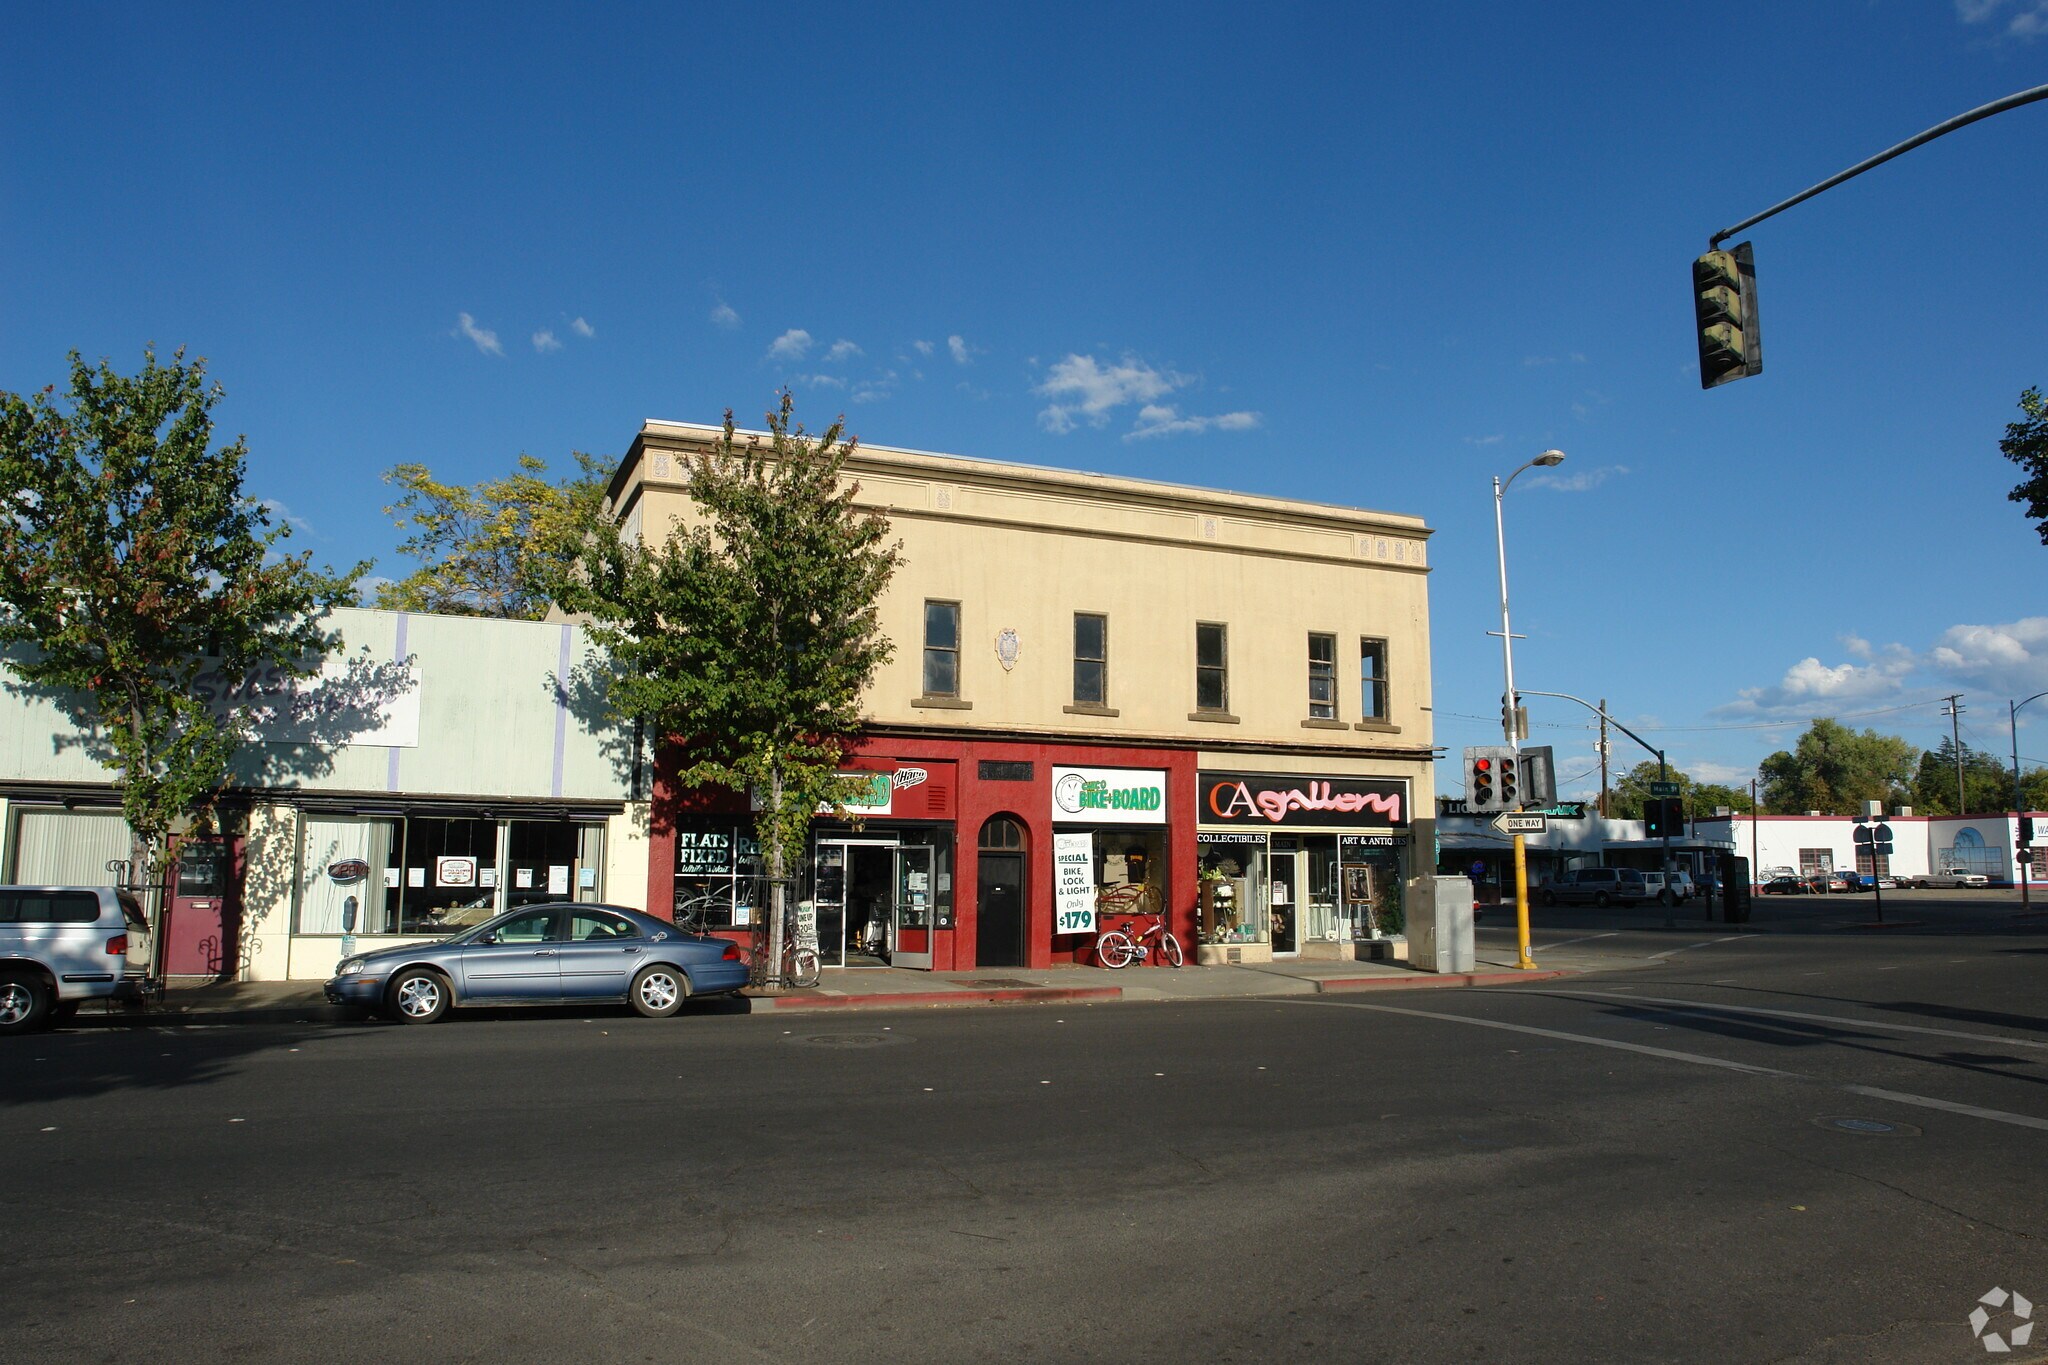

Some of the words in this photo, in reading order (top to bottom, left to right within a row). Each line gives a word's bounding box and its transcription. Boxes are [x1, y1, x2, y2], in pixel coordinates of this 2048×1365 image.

[1508, 819, 1523, 828] ONE
[1525, 819, 1541, 827] WAY
[681, 833, 729, 848] FLATS
[1197, 834, 1266, 844] COLLECTIBILES
[1342, 836, 1358, 845] ART
[1360, 837, 1368, 845] &
[1370, 837, 1407, 846] ANTIQUES
[680, 848, 728, 864] FIXED
[1058, 853, 1088, 862] SPECIAL
[1063, 868, 1084, 876] BIKE,
[1063, 877, 1085, 886] LOCK
[1058, 888, 1064, 896] &
[1066, 886, 1090, 895] LIGHT
[1066, 899, 1084, 909] Only
[1059, 910, 1092, 929] $179
